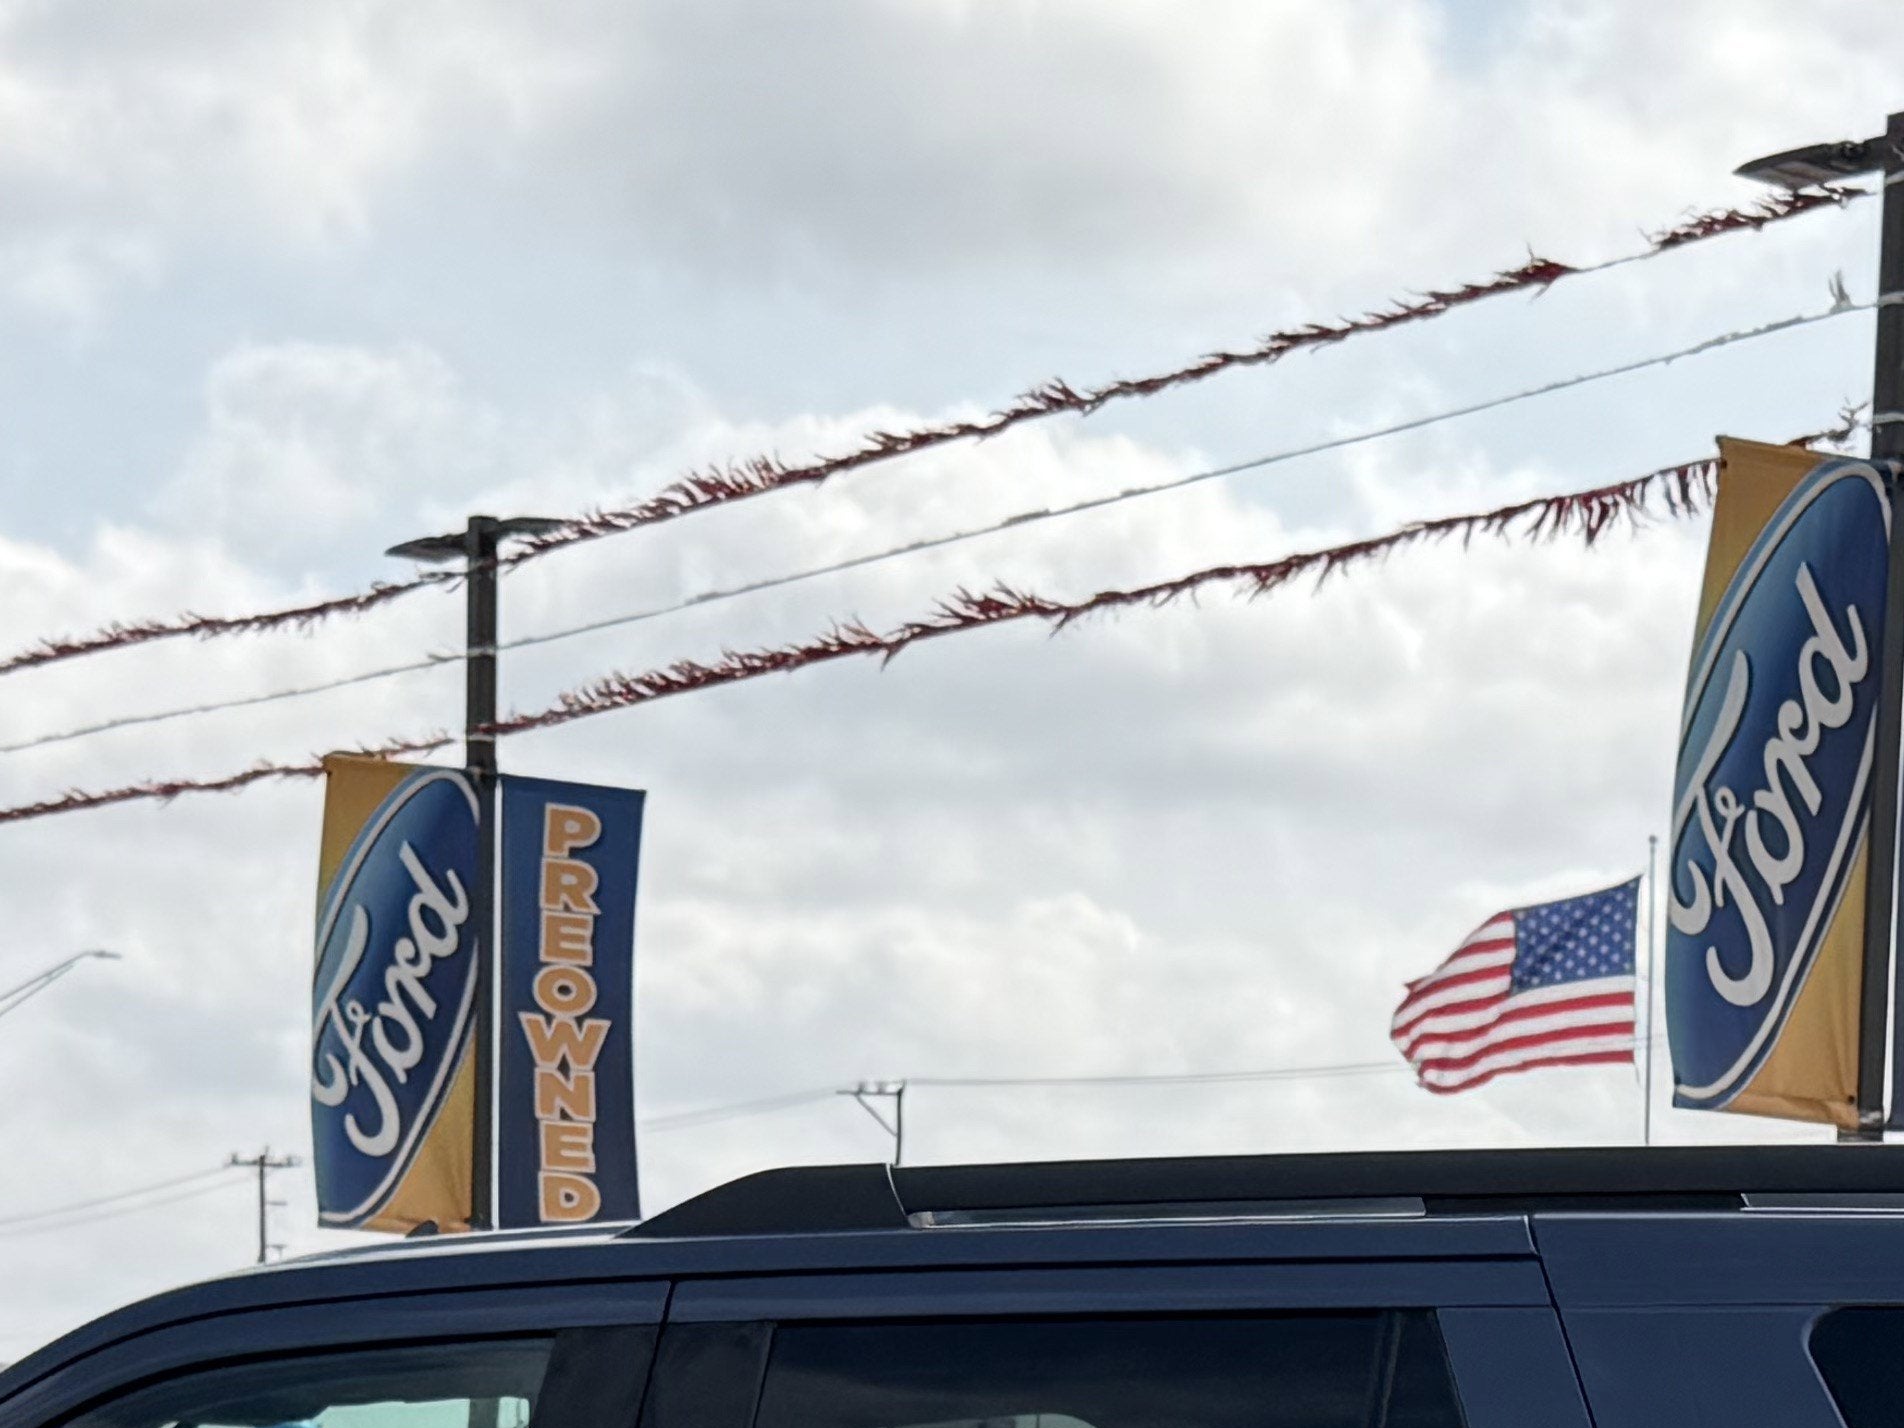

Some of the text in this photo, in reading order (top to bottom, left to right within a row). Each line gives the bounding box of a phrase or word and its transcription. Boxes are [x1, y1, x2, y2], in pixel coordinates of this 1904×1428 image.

[1669, 561, 1869, 1007] Ford
[311, 840, 470, 1157] Ford
[517, 802, 612, 1223] PREOWNED
